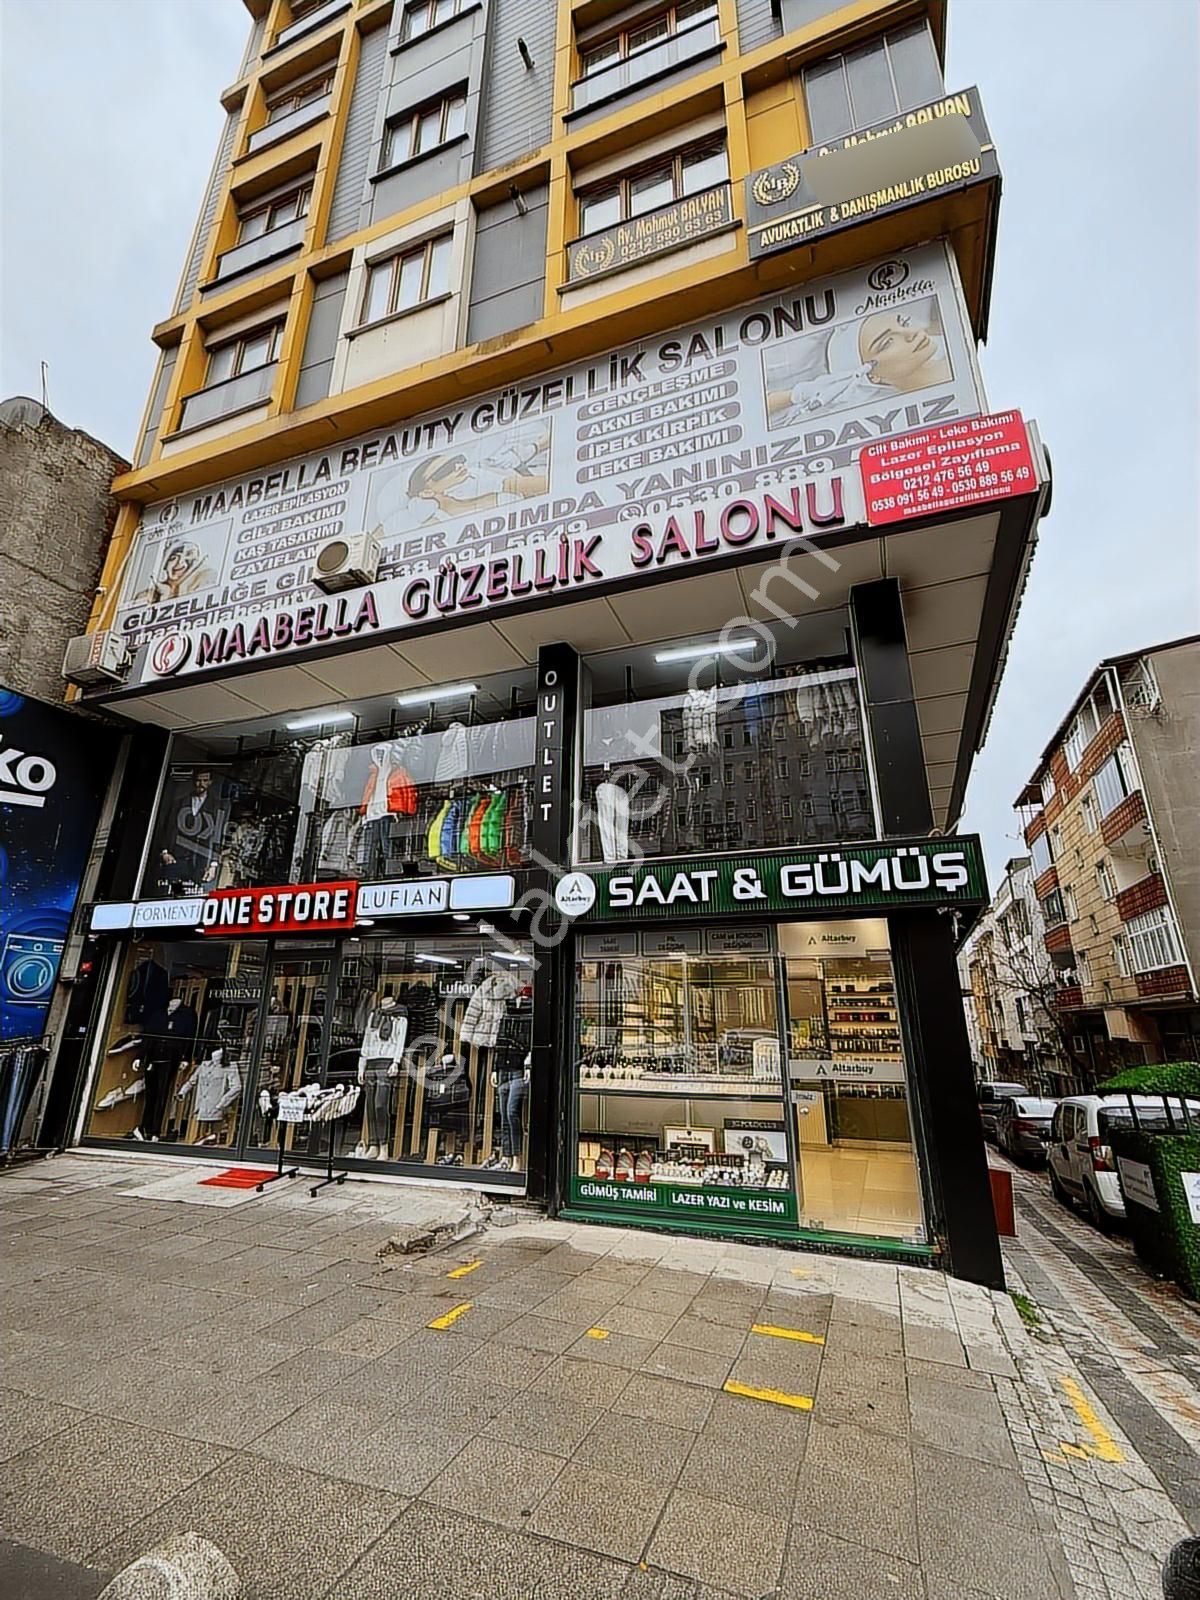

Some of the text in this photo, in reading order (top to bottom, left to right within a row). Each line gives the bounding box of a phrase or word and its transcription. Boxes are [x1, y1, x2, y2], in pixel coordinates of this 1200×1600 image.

[617, 228, 634, 247] Av.
[636, 212, 678, 237] Mahmut
[681, 189, 725, 221] BALYAN
[621, 236, 653, 257] 0212
[684, 218, 702, 233] 63
[705, 210, 722, 224] 63
[760, 211, 825, 247] AVUKATLIK
[829, 204, 841, 223] &
[840, 177, 926, 214] DANIŞMANLIK
[191, 288, 837, 525] MAABELLA BEAUTY GÜZELLİK SALONU
[587, 363, 726, 414] GENÇLEŞME
[587, 382, 727, 437] AKNE BAKIMI
[588, 407, 728, 459] İPEK KİRPİK
[588, 428, 730, 479] LEKE BAKIMI
[868, 443, 888, 458] Cilt
[890, 434, 931, 454] Bakımı
[940, 425, 968, 440] Leke
[971, 414, 1014, 431] Bakımı
[880, 430, 1004, 467] Lazer Epilasyon
[870, 460, 937, 484] Bölgesel
[871, 495, 896, 512] 0538
[897, 491, 914, 506] 091
[917, 487, 930, 501] 56
[931, 484, 944, 498] 49
[952, 478, 977, 494] 0530
[1001, 469, 1014, 482] 56
[1016, 467, 1030, 480] 49
[903, 461, 990, 491] 0212 476 56 49
[123, 580, 268, 631] GÜZELLİĞE
[380, 531, 448, 563] HER
[456, 490, 604, 544] ADIMDA
[616, 395, 960, 500] YANINIZDAYIZ
[244, 502, 281, 524] LAZER
[281, 503, 343, 529] BAKIMI
[236, 522, 340, 562] KAŞ TASARIMI
[196, 476, 845, 667] MAABELLA GÜZELLİK SALONU
[541, 670, 558, 822] OUTLET
[361, 887, 442, 910] LUFIAN
[608, 847, 969, 907] SAAT & GÜMÜŞ
[203, 889, 349, 926] ONE STORE
[208, 988, 262, 999] FORMENTI
[832, 1063, 874, 1074] Altarbuy
[580, 1183, 657, 1202] GÜMÜŞ TAMİRİ
[672, 1192, 785, 1214] LAZER YAZI ve KESİM
